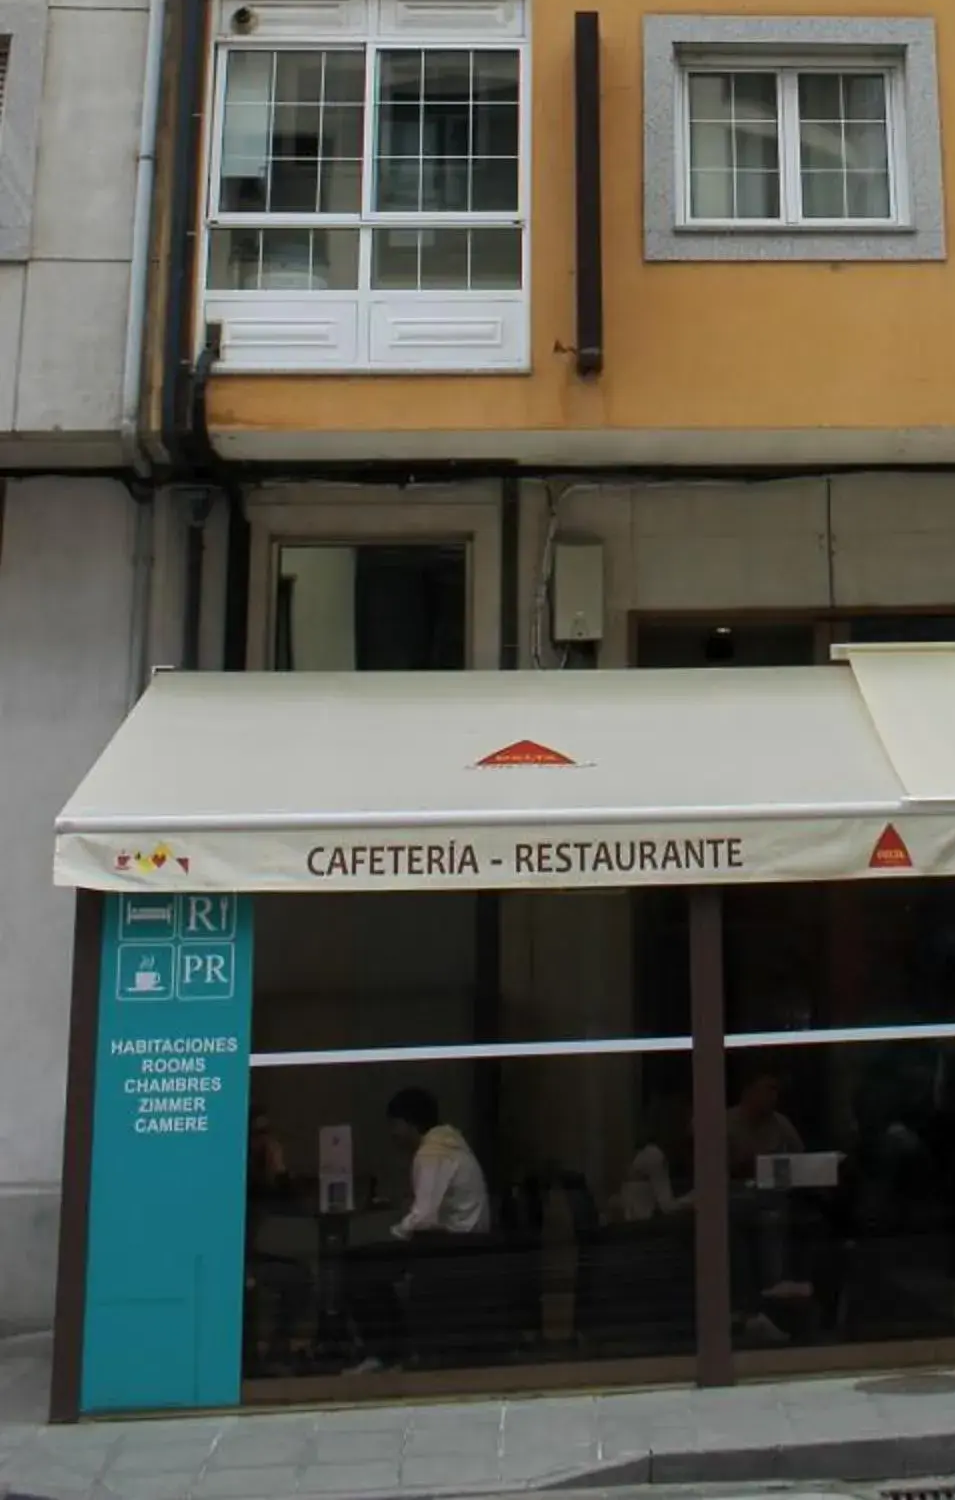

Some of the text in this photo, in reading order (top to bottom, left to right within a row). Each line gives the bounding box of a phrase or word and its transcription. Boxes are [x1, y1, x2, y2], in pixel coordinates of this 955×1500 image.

[307, 840, 480, 876] CAFETERÍA
[514, 838, 743, 874] RESTAURANTE
[183, 954, 228, 984] PR
[111, 1037, 238, 1054] HABITACIONES
[141, 1057, 206, 1073] ROOMS
[124, 1077, 222, 1094] CHAMBRES
[138, 1097, 206, 1113] ZIMMER
[135, 1116, 208, 1133] CAMERE
